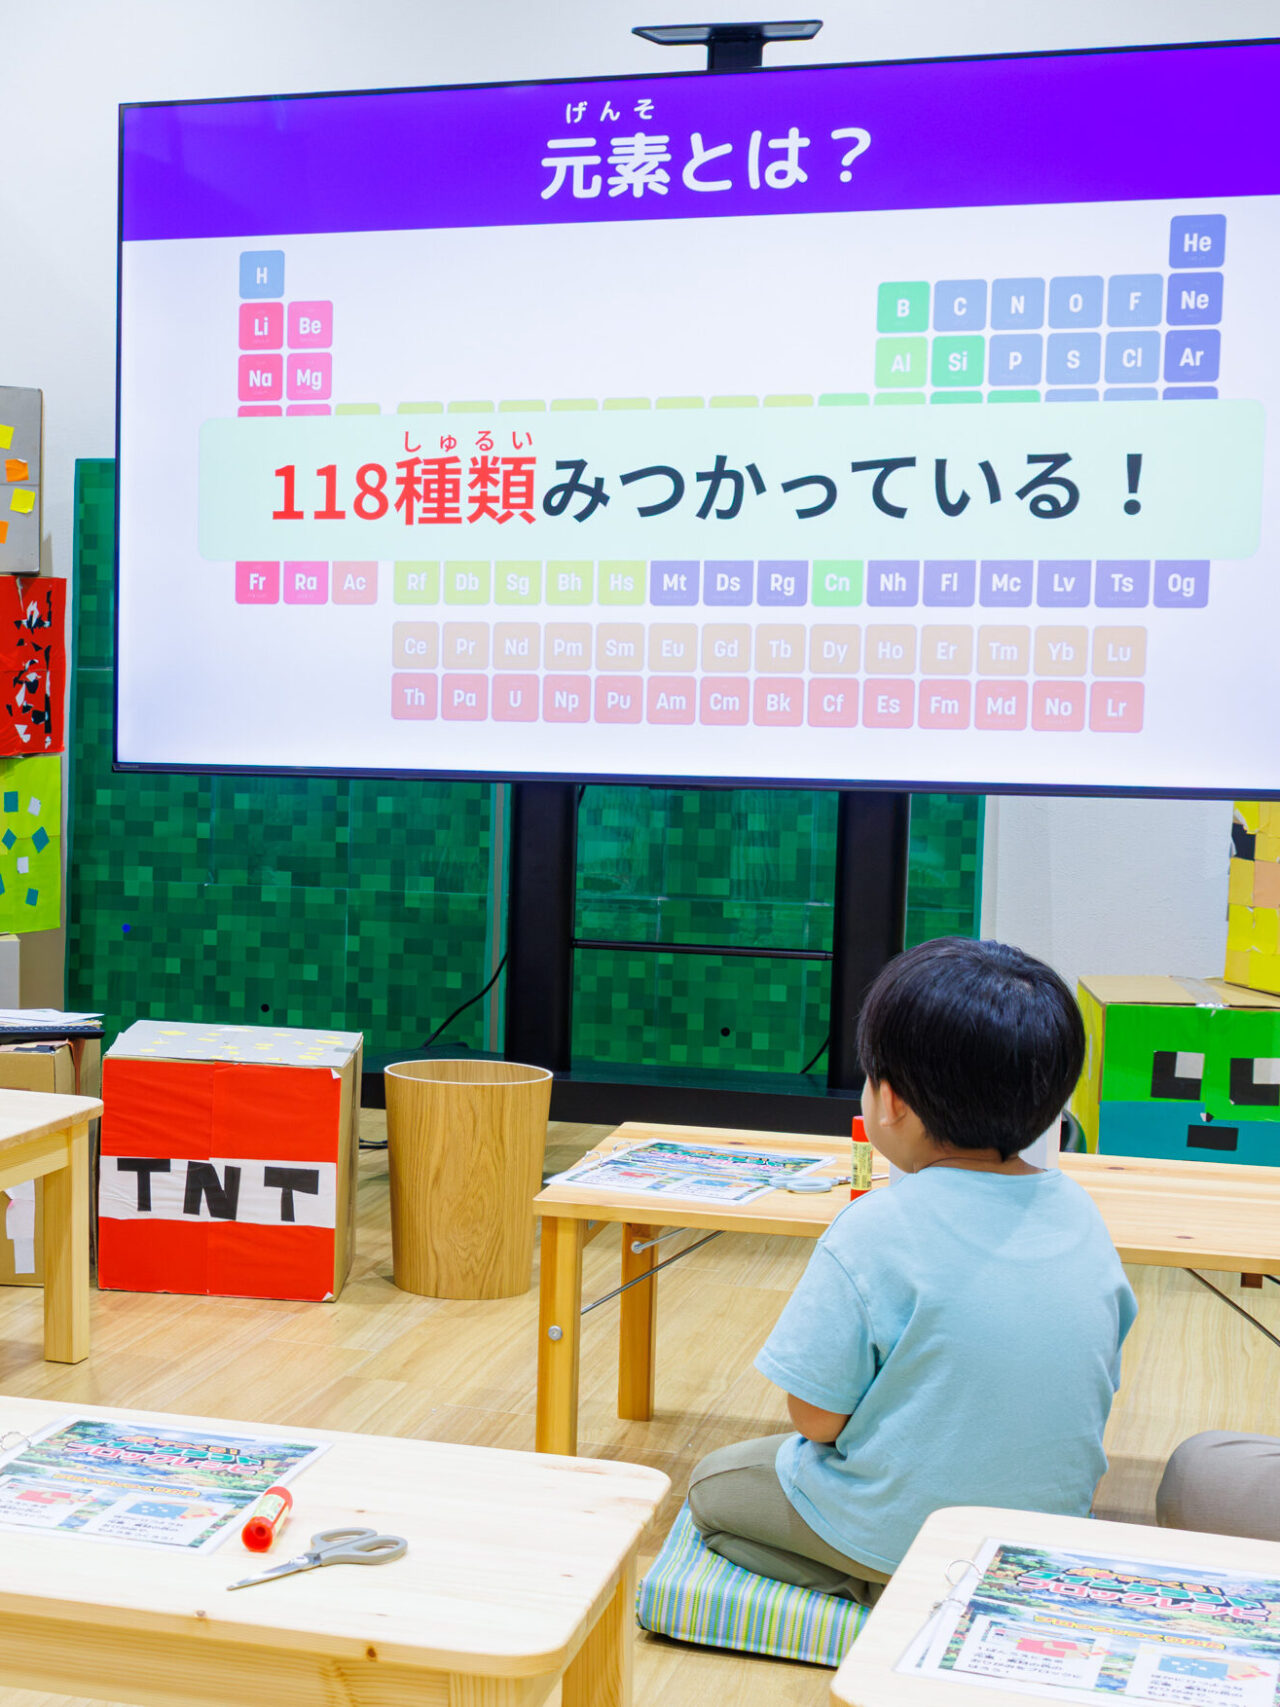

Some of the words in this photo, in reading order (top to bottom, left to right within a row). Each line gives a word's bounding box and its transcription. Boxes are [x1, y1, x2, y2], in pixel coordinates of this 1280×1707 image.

[565, 98, 655, 124] げんそ
[540, 126, 872, 200] 元素とは？
[257, 267, 267, 284] H
[1184, 233, 1211, 252] He
[255, 317, 268, 336] Li
[299, 317, 321, 334] Be
[897, 299, 910, 317] B
[954, 297, 966, 316] C
[1011, 296, 1024, 314] N
[1069, 294, 1082, 312] O
[1130, 292, 1141, 310] F
[1181, 291, 1209, 309] Ne
[249, 370, 272, 387] Na
[297, 369, 322, 391] Mg
[891, 352, 911, 372] Al
[949, 351, 967, 371] Si
[1009, 352, 1022, 370] P
[1067, 350, 1080, 368] S
[1123, 348, 1142, 367] Cl
[1180, 348, 1204, 366] Ar
[404, 430, 533, 452] しゅるい
[272, 452, 1143, 526] 118種類みつかっている！
[250, 573, 266, 590] Fr
[295, 573, 317, 590] Ra
[344, 574, 366, 590] Ac
[407, 572, 427, 591] Rf
[455, 572, 480, 591] Db
[506, 573, 530, 596] Sg
[558, 572, 582, 591] Bh
[609, 573, 634, 592] Hs
[663, 574, 686, 591] Mt
[717, 574, 740, 591] Ds
[771, 574, 794, 596] Rg
[825, 573, 850, 591] Cn
[880, 573, 906, 591] Nh
[941, 573, 957, 591] Fl
[992, 574, 1021, 591] Mc
[1054, 574, 1075, 592] Lv
[1111, 574, 1133, 592] Ts
[1168, 574, 1195, 597] Og
[404, 636, 427, 655] Ce
[456, 638, 476, 655] Pr
[504, 637, 529, 656] Nd
[554, 638, 583, 656] Pm
[606, 639, 634, 656] Sm
[661, 639, 684, 657] Eu
[714, 638, 738, 658] Gd
[769, 639, 792, 658] Tb
[823, 640, 848, 664] Dy
[878, 640, 904, 659] Ho
[936, 640, 957, 660] Er
[989, 642, 1018, 660] Tm
[1048, 641, 1074, 661] Yb
[1108, 643, 1131, 662] Lu
[404, 688, 425, 705] Th
[454, 689, 476, 706] Pa
[509, 690, 522, 707] U
[555, 691, 579, 712] Np
[607, 692, 631, 709] Pu
[656, 692, 686, 709] Am
[710, 693, 739, 710] Cm
[767, 693, 790, 712] Bk
[823, 694, 844, 712] Cf
[877, 695, 900, 713] Es
[930, 696, 959, 714] Fm
[987, 696, 1016, 715] Md
[1045, 698, 1072, 716] No
[1107, 699, 1127, 717] Lr
[117, 1157, 319, 1222] TNT
